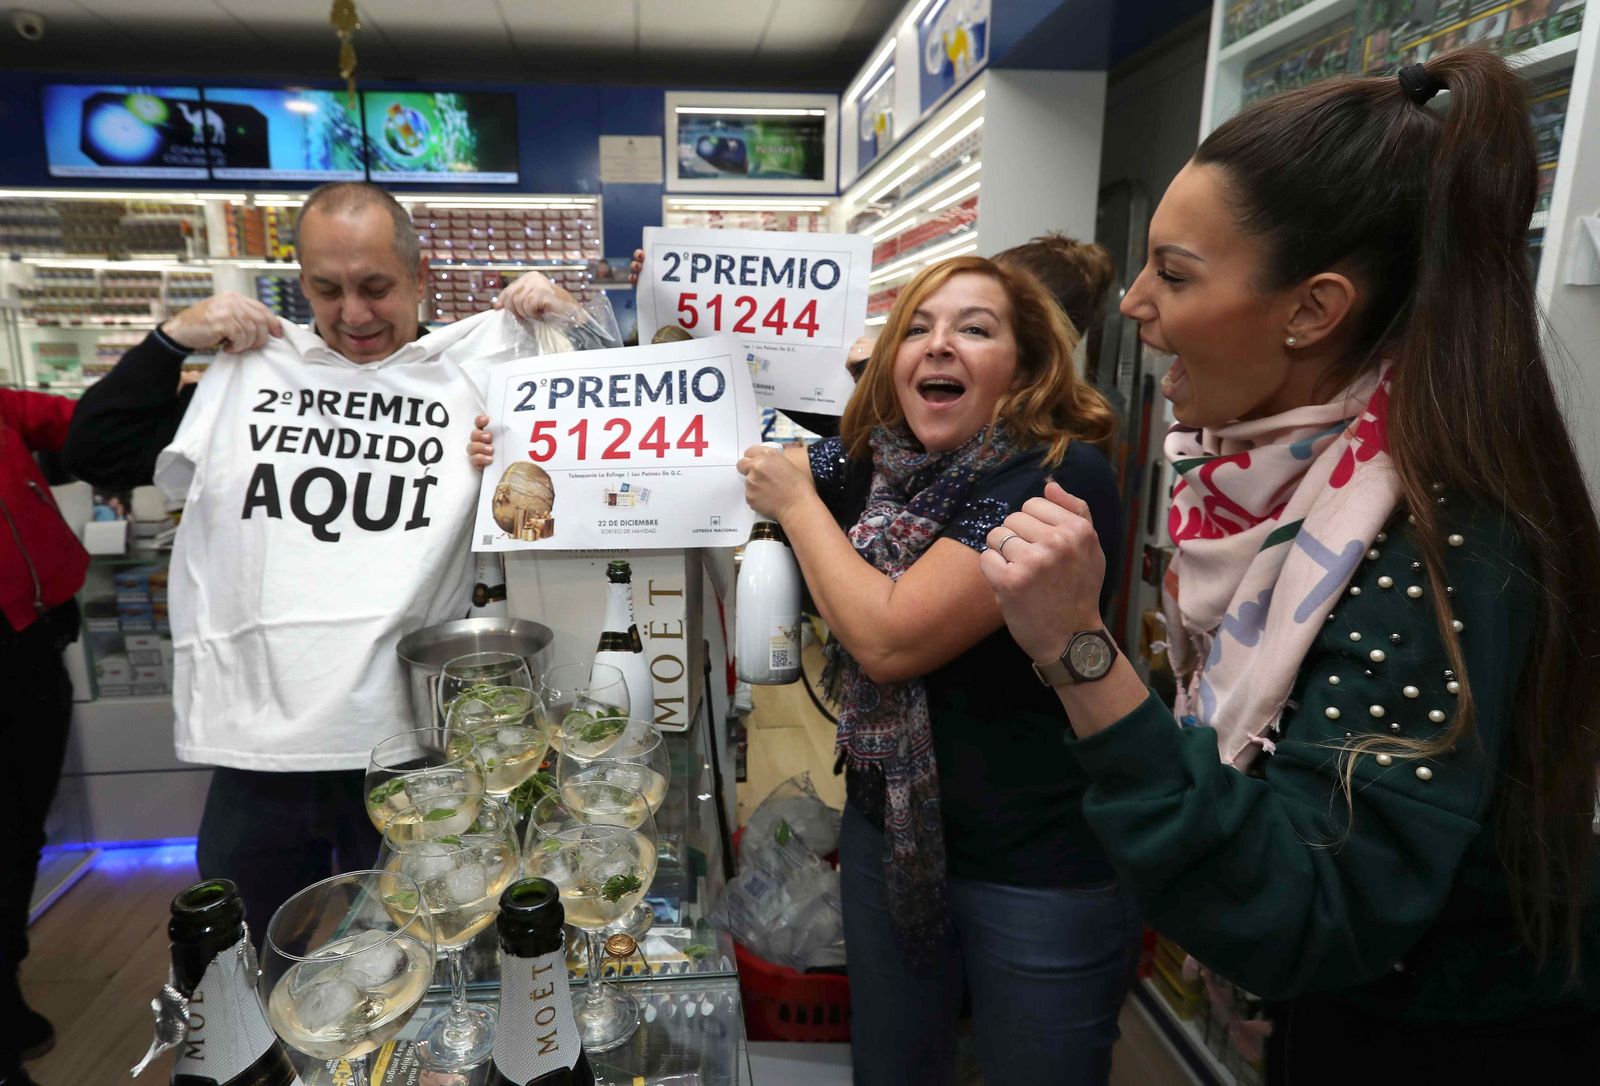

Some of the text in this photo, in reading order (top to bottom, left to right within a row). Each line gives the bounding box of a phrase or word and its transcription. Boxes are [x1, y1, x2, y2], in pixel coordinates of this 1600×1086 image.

[690, 253, 841, 290] PREMIO
[677, 292, 820, 338] 51244
[297, 389, 449, 428] PREMIO
[548, 366, 726, 410] PREMIO
[249, 424, 444, 466] VENDIDO
[528, 414, 709, 463] 51244
[241, 463, 438, 542] AQUÍ
[597, 519, 659, 527] 22 DE DICIEMBRE
[643, 580, 685, 727] MOËT
[530, 962, 559, 1057] MOËT
[386, 1058, 400, 1083] amigos
[406, 1068, 418, 1086] malo
